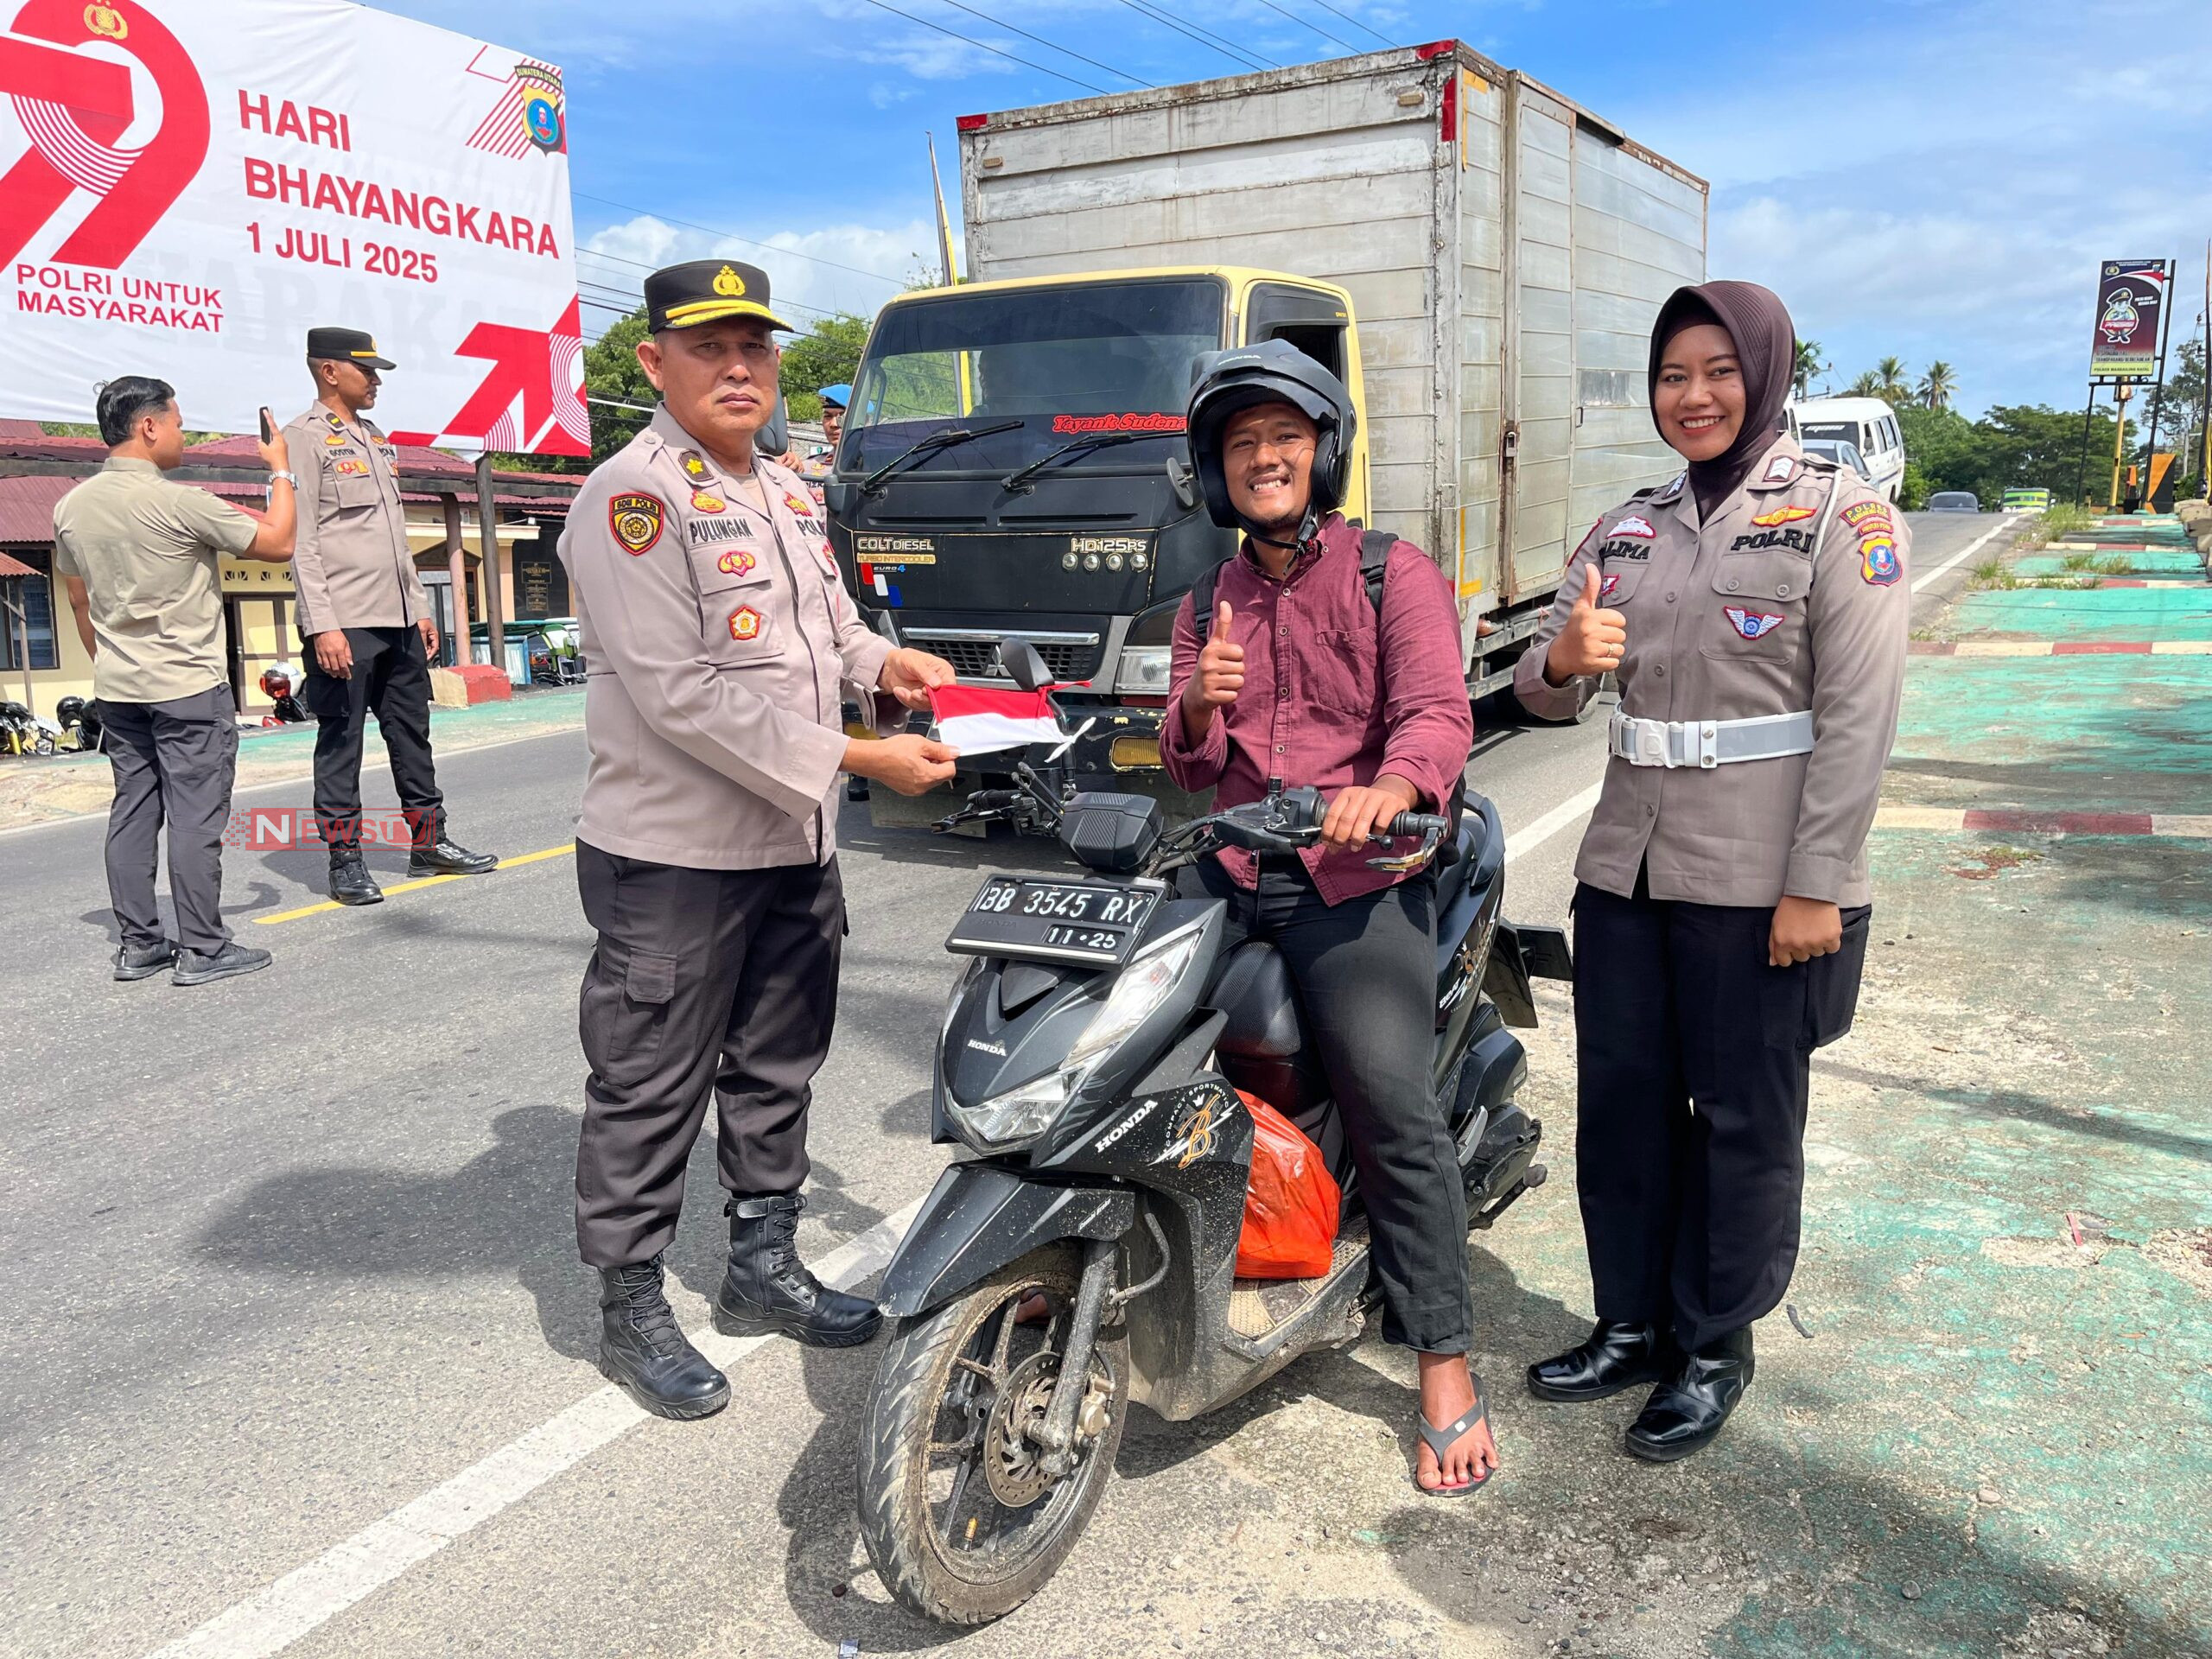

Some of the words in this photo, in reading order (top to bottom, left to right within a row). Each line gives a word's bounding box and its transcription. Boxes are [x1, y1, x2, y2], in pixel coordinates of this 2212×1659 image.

[238, 89, 351, 152] HARI
[245, 156, 560, 259] BHAYANGKARA
[246, 221, 261, 253] 1
[276, 228, 351, 268] JULI
[363, 242, 439, 283] 2025
[16, 264, 112, 296] POLRI
[123, 276, 223, 309] UNTUK
[17, 290, 225, 334] MASYARAKAT
[1052, 414, 1121, 434] Yayank
[690, 518, 754, 544] PULUNGAN
[1730, 528, 1814, 554] POLRI
[897, 564, 906, 573] 4
[978, 887, 1017, 912] BB
[1022, 890, 1092, 918] 3545
[1100, 896, 1143, 924] RX
[968, 1038, 1007, 1057] HONDA
[1094, 1099, 1159, 1154] HONDA
[1165, 1096, 1186, 1148] COMPACT
[1188, 1083, 1230, 1109] SPORTMATIC
